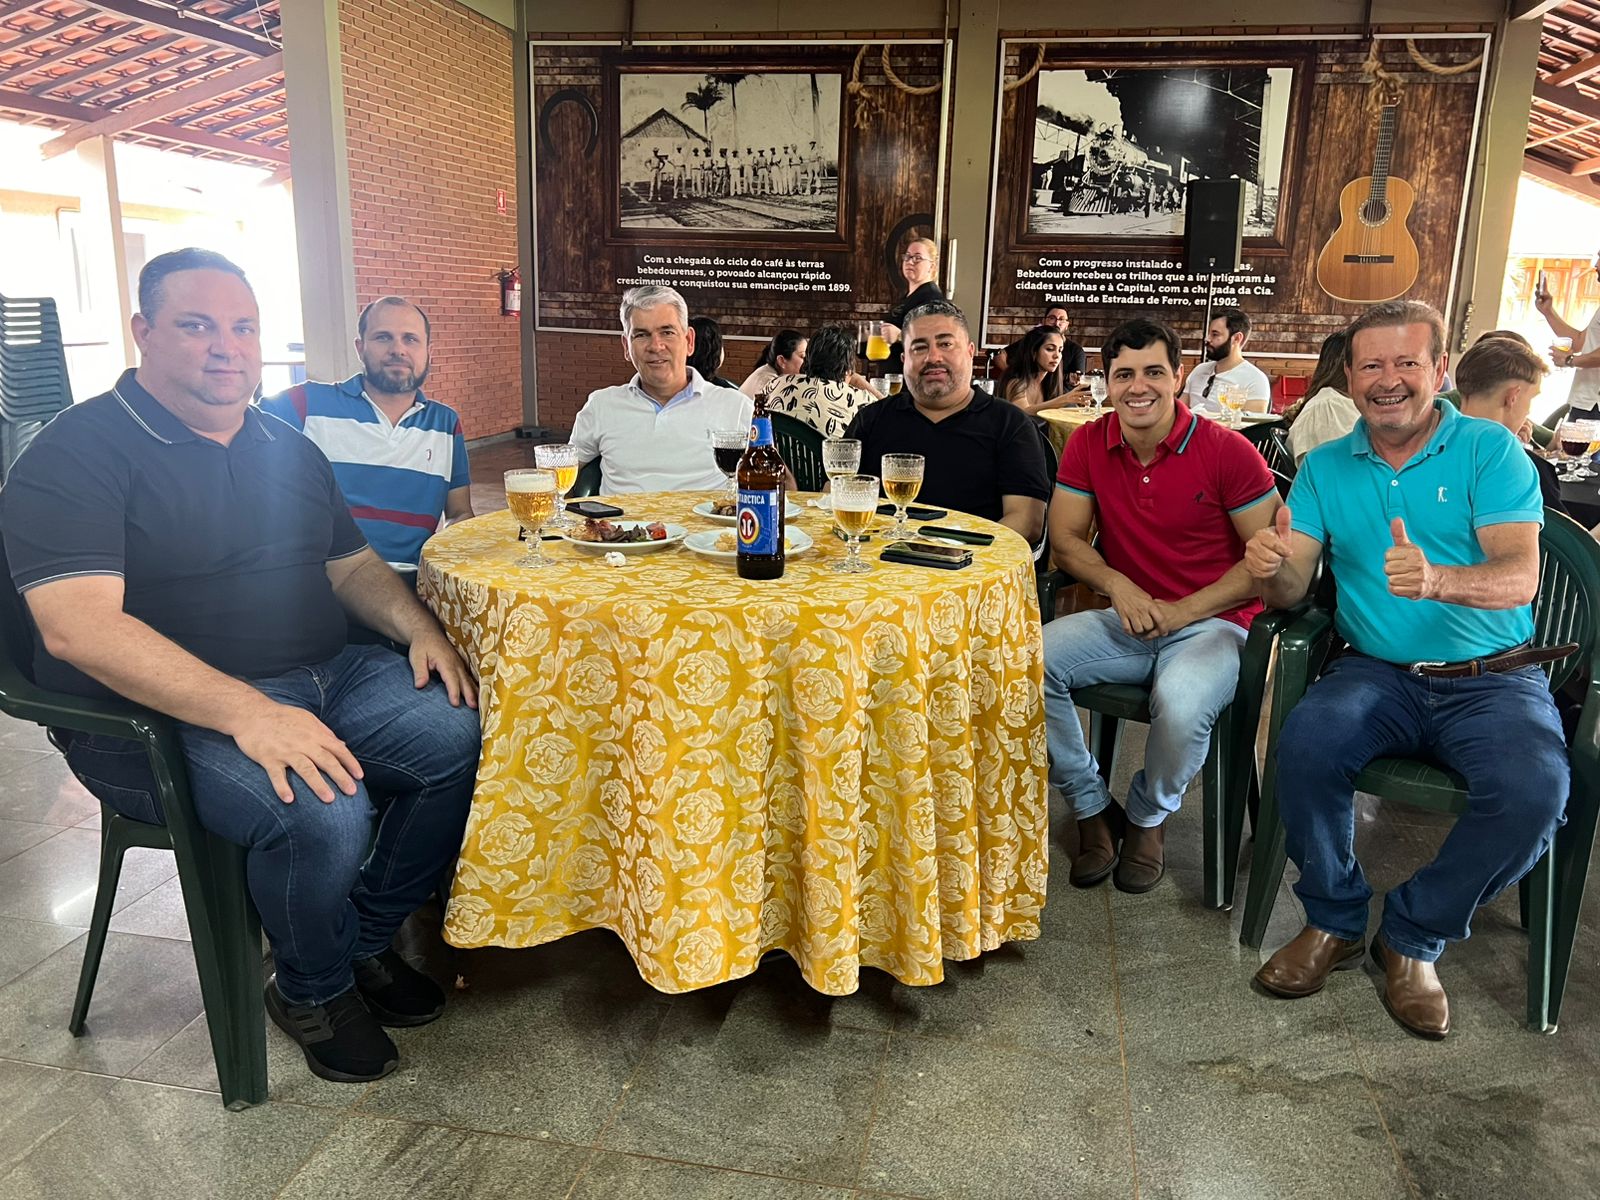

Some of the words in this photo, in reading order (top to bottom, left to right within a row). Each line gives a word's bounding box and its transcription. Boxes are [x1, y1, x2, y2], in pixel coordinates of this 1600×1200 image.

[644, 255, 664, 264] Com
[674, 256, 711, 266] chegada
[727, 257, 748, 266] ciclo
[750, 258, 762, 266] do
[764, 258, 783, 267] café
[786, 259, 795, 267] às
[798, 260, 824, 268] terras
[1039, 258, 1062, 266] Com
[1073, 260, 1123, 269] progresso
[1126, 260, 1173, 268] instalado
[637, 266, 706, 277] bebedourenses,
[717, 270, 755, 278] povoado
[757, 270, 799, 280] alcançou
[801, 271, 831, 281] rápido
[1017, 269, 1070, 278] Bebedouro
[1073, 271, 1113, 279] recebeu
[1129, 272, 1163, 280] trilhos
[1165, 274, 1185, 283] que
[1264, 274, 1276, 283] às
[616, 277, 670, 286] crescimento
[680, 280, 730, 288] conquistou
[750, 282, 810, 292] emancipação
[828, 284, 852, 292] 1899.
[1016, 281, 1053, 290] cidades
[1055, 282, 1097, 291] vizinhas
[1108, 283, 1114, 291] à
[1116, 283, 1155, 293] Capital,
[1238, 286, 1251, 294] da
[1254, 286, 1274, 295] Cia.
[1045, 293, 1085, 302] Paulista
[1087, 294, 1099, 303] de
[1102, 295, 1144, 304] Estradas
[1147, 296, 1159, 304] de
[1162, 296, 1191, 306] Ferro,
[1212, 297, 1240, 306] 1902.
